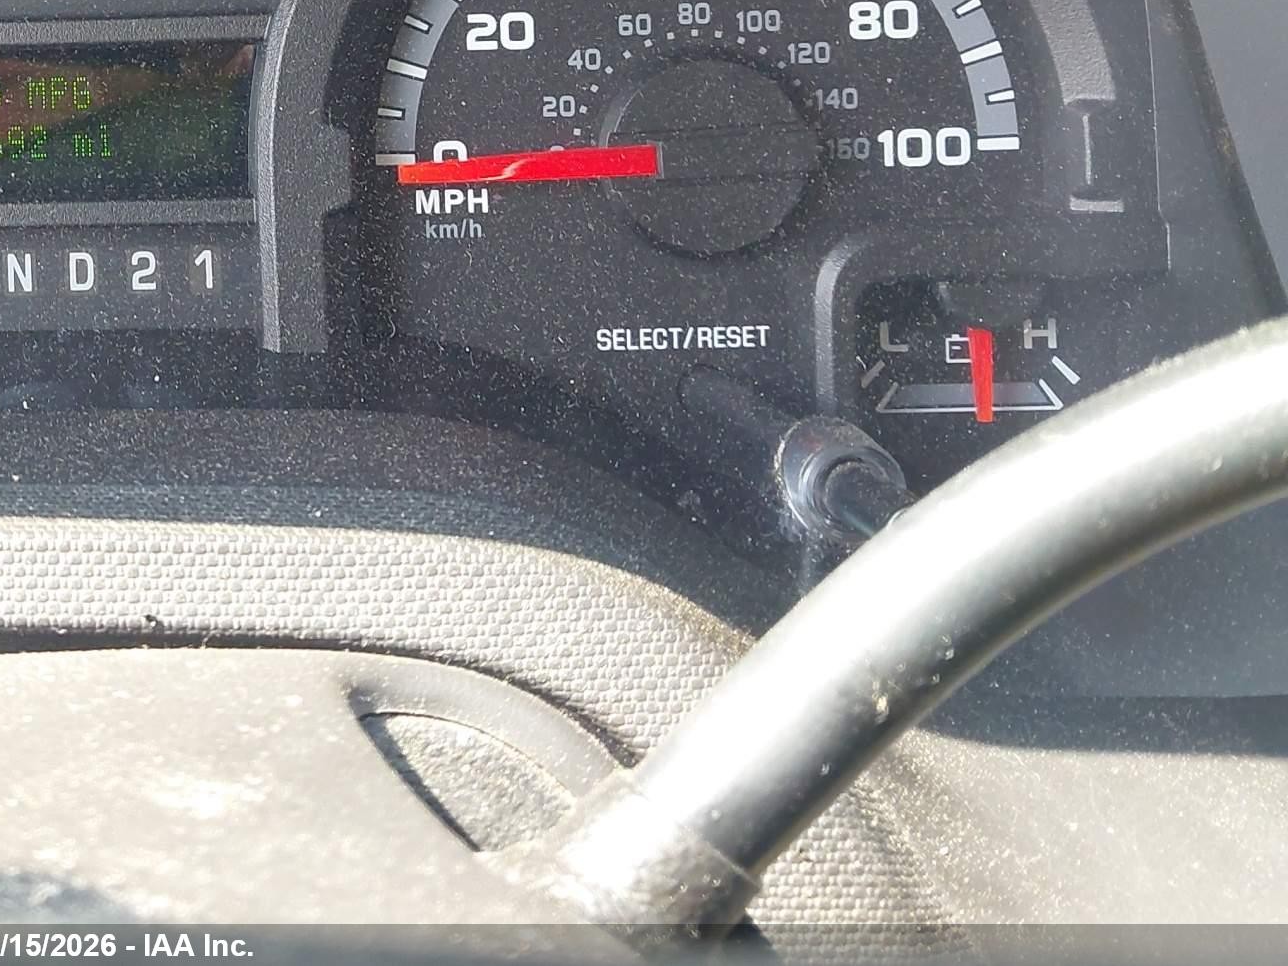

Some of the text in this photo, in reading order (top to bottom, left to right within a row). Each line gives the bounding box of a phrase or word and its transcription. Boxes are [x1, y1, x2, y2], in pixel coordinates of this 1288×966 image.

[618, 13, 652, 36] 60
[677, 2, 712, 25] 80
[736, 9, 782, 33] 100
[849, 0, 919, 40] 80
[466, 11, 535, 51] 20
[567, 48, 602, 71] 40
[787, 41, 831, 64] 120
[542, 95, 576, 118] 20
[816, 87, 859, 110] 140
[877, 127, 971, 167] 100
[415, 188, 489, 215] MPH
[425, 218, 483, 239] km/h
[7, 253, 33, 293] N
[69, 251, 95, 291] D
[131, 250, 157, 291] 2
[194, 249, 214, 289] 1
[596, 325, 770, 352] SELECT/RESET
[880, 322, 910, 353] L
[1023, 319, 1058, 350] H
